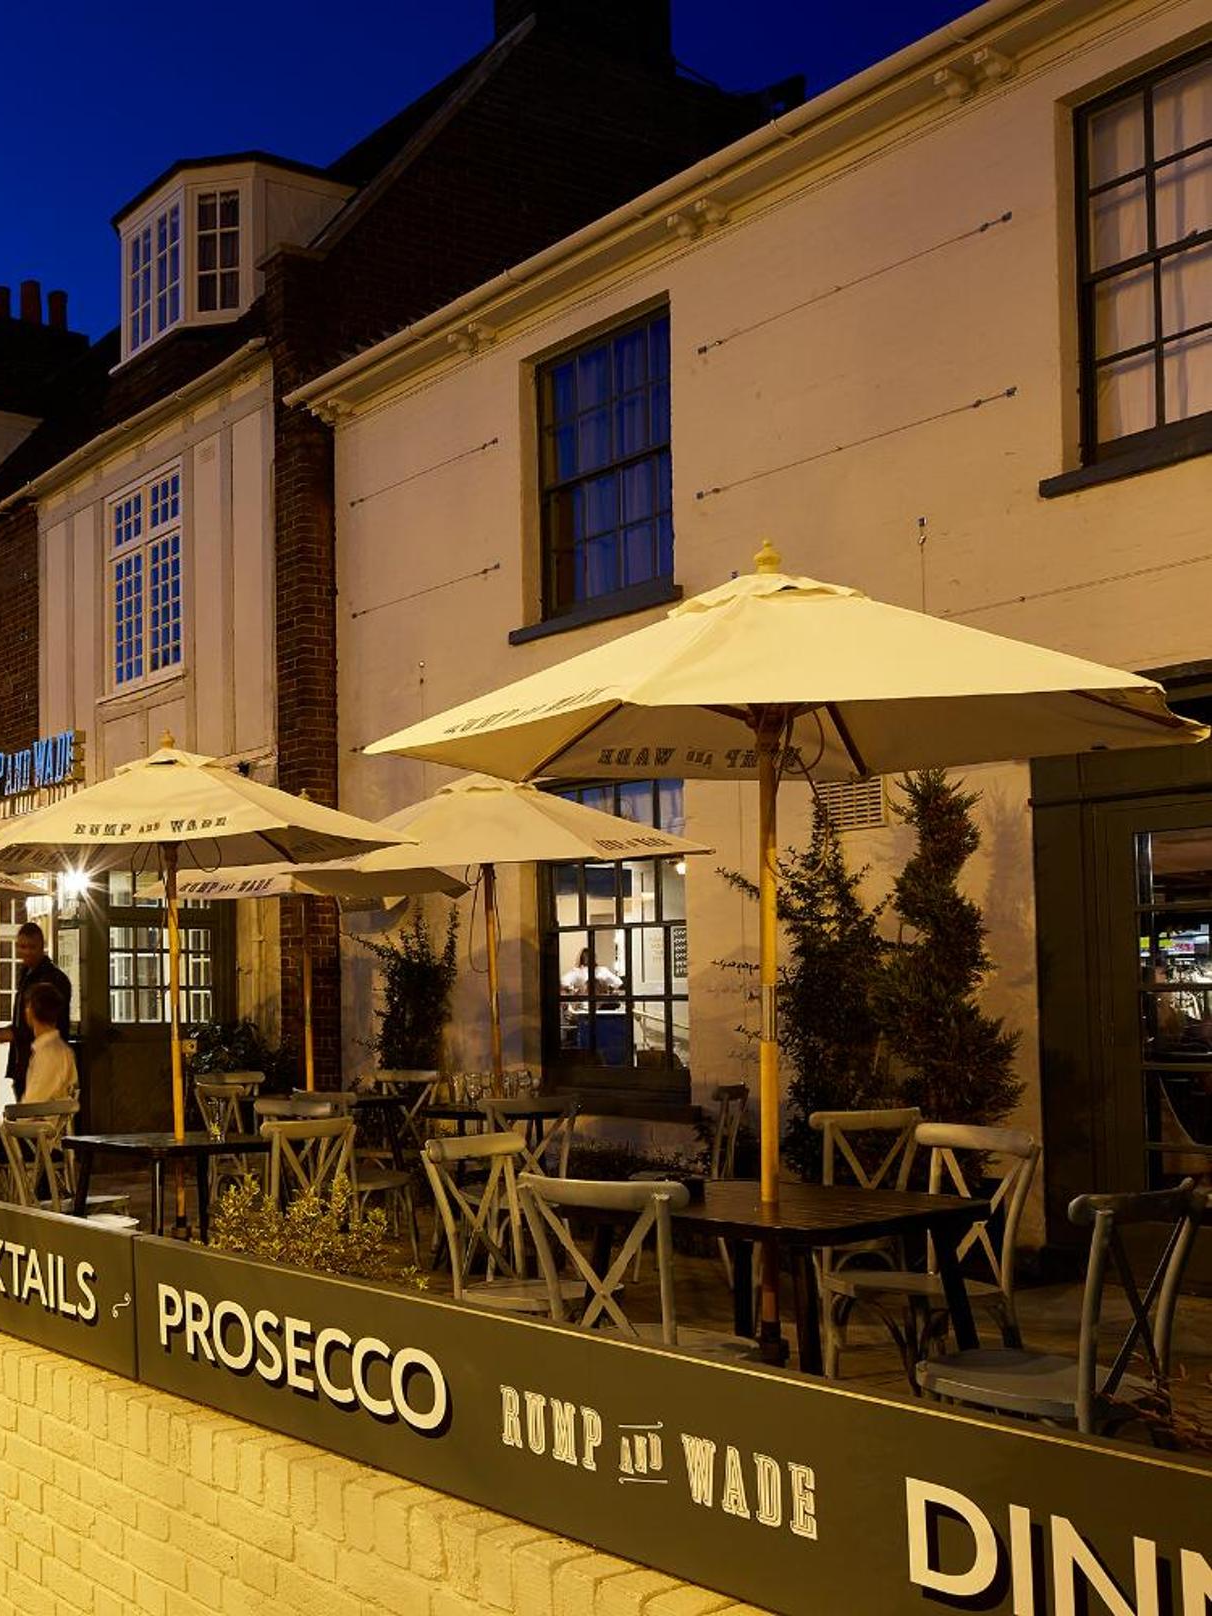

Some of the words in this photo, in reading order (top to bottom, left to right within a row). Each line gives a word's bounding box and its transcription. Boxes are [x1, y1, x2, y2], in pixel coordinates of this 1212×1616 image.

[74, 823, 132, 836] RUMP
[170, 816, 228, 833] WADE
[238, 877, 275, 893] WADE
[158, 1282, 448, 1432] PROSECCO
[500, 1384, 603, 1473] RUMP
[618, 1431, 664, 1475] AND
[681, 1432, 818, 1541] WADE
